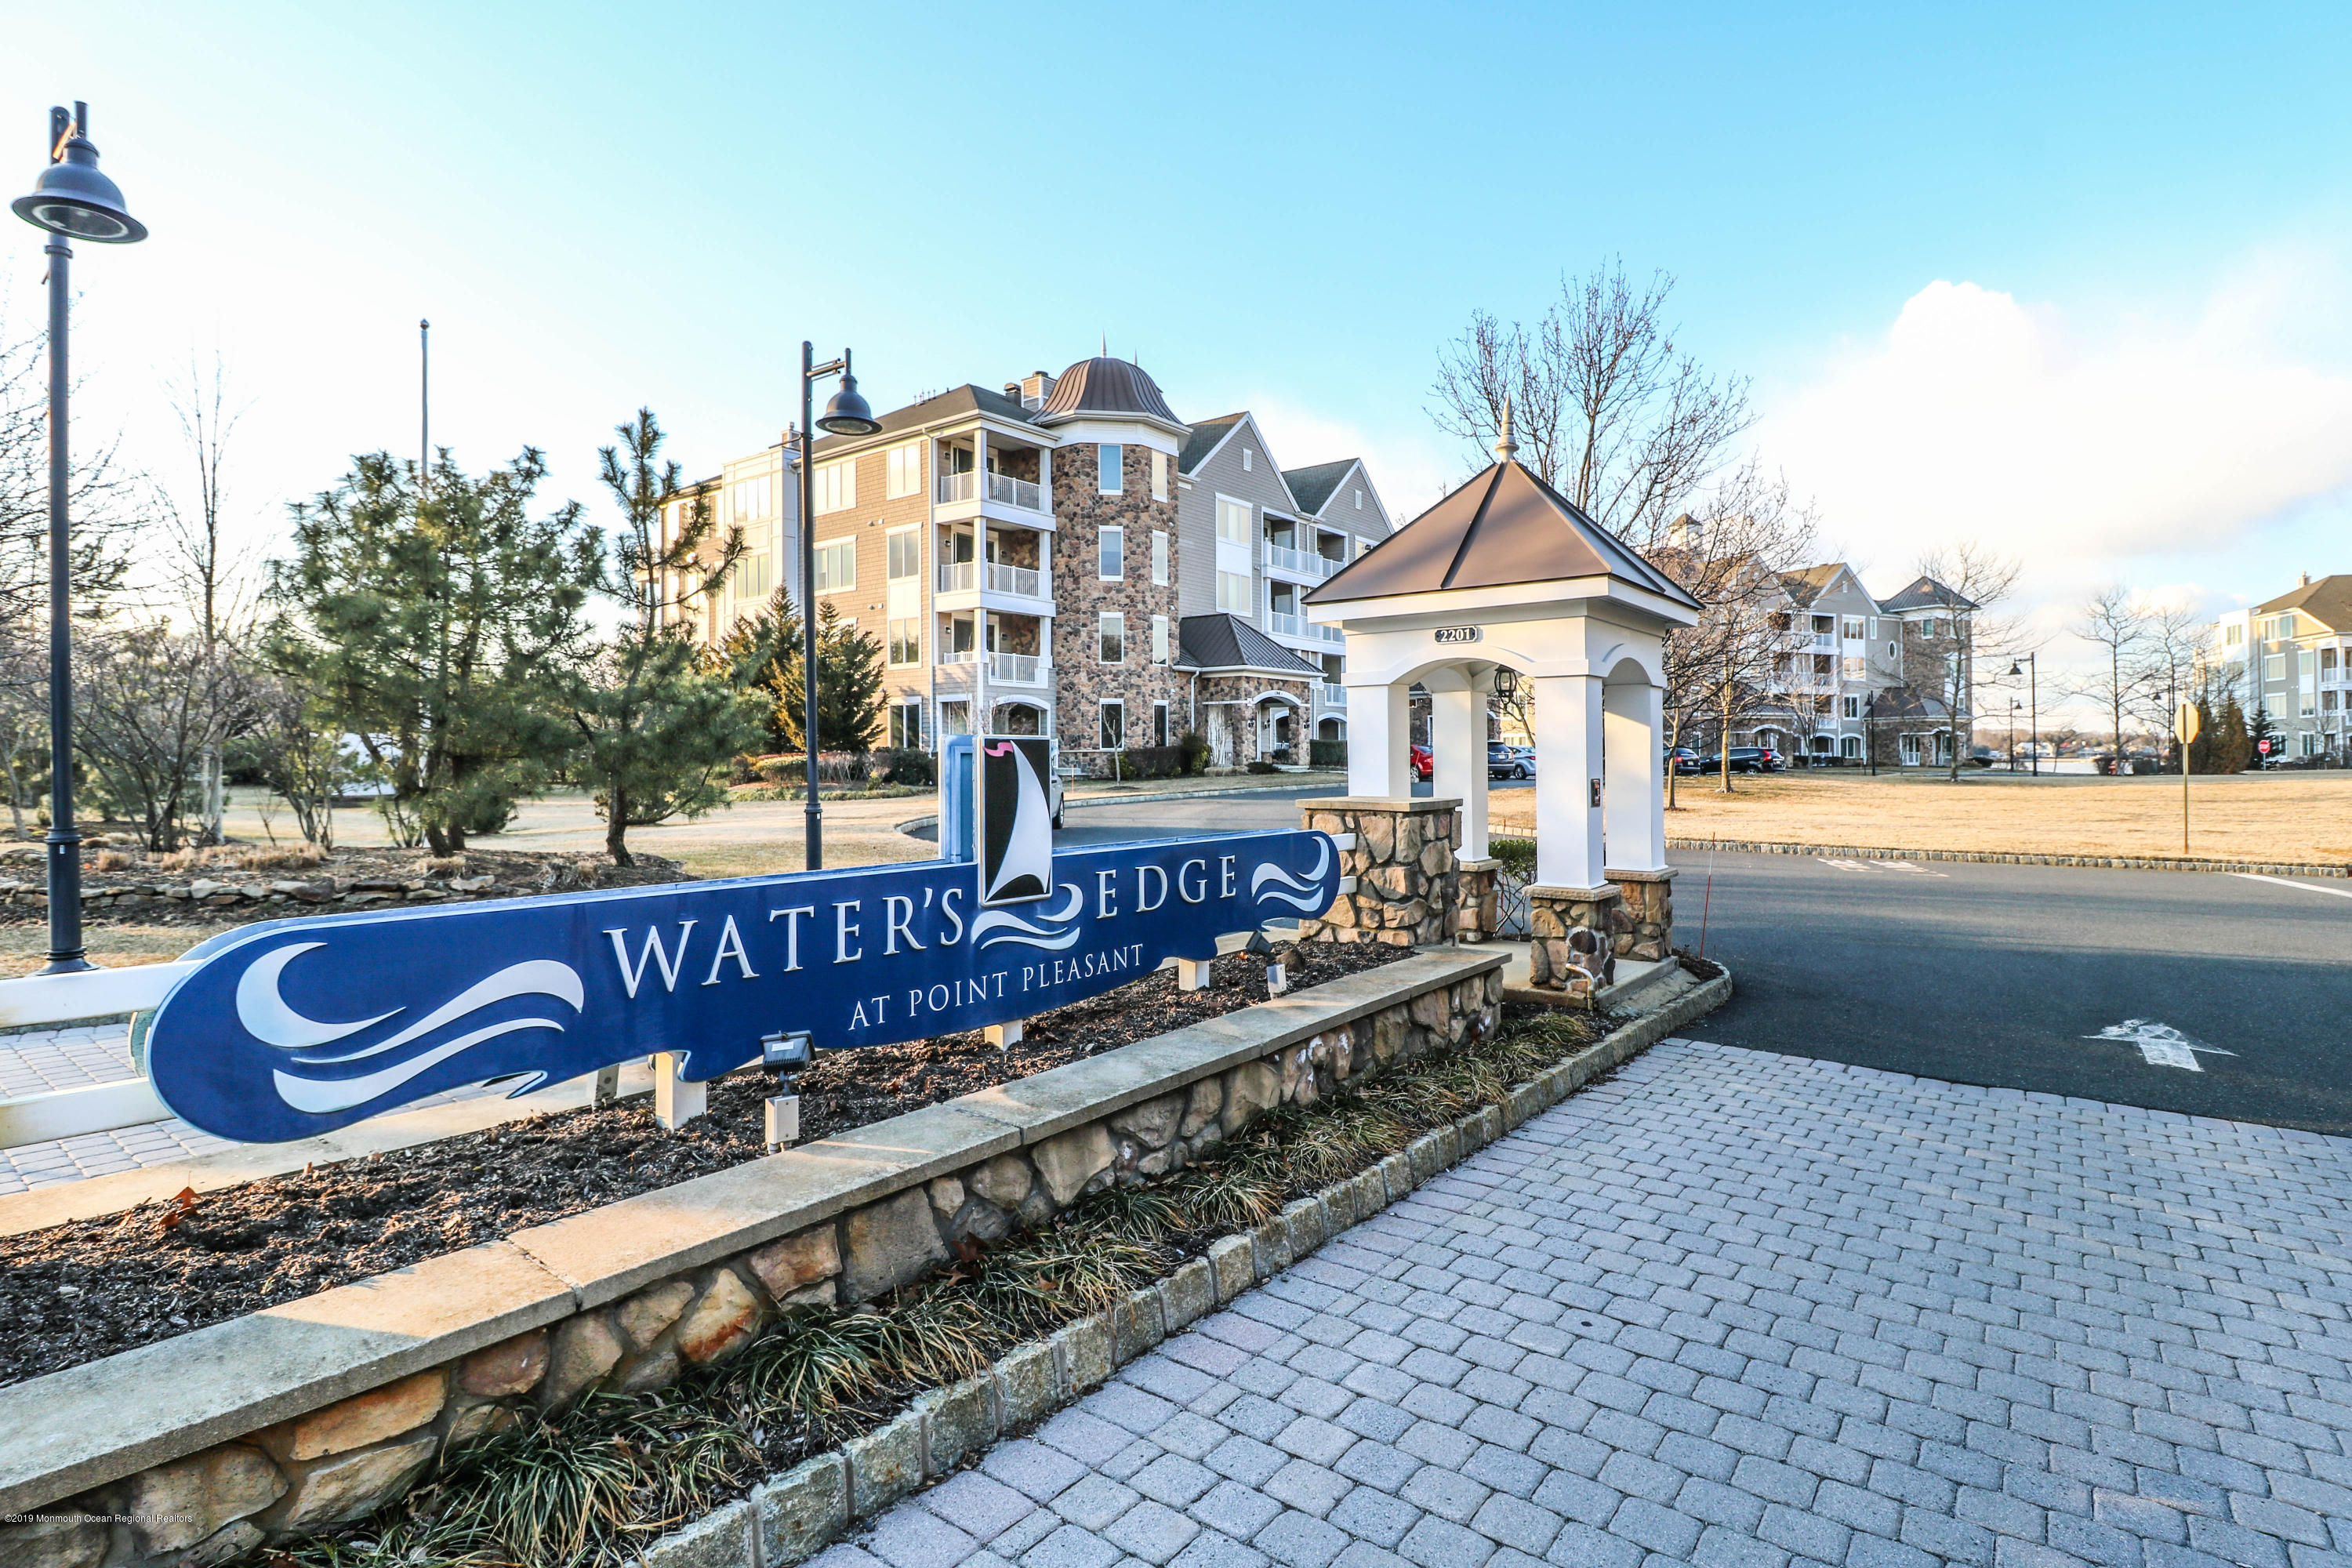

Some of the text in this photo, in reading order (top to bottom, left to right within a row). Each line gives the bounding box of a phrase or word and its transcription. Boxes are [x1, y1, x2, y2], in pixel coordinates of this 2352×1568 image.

[1440, 628, 1471, 642] 2201
[602, 855, 1236, 999] WATER'S EDGE
[848, 943, 1144, 1031] AT POINT PLEASANT
